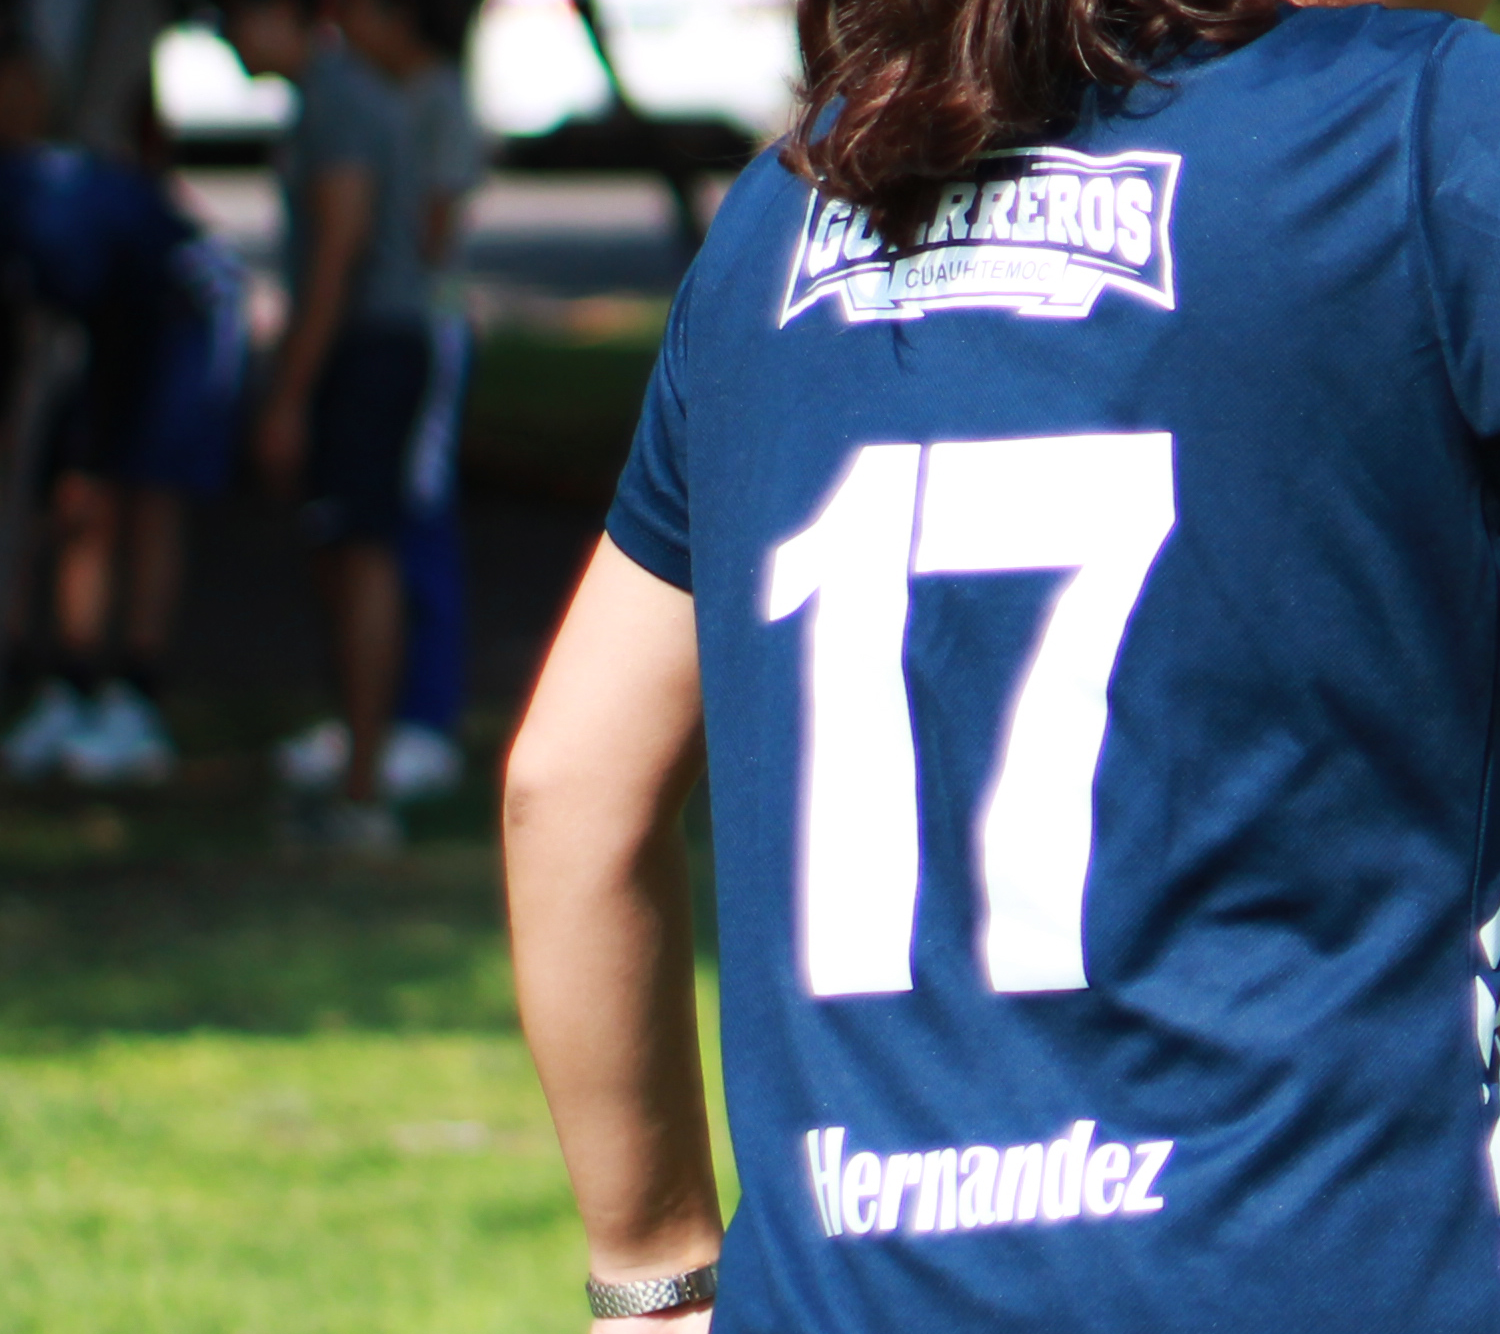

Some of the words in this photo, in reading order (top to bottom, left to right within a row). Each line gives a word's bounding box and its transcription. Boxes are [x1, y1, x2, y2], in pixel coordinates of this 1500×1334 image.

[809, 174, 1153, 278] GURREROS
[905, 259, 1052, 289] CUAUHTEMOC
[768, 432, 1175, 995] 17
[807, 1120, 1174, 1237] Hernandez
